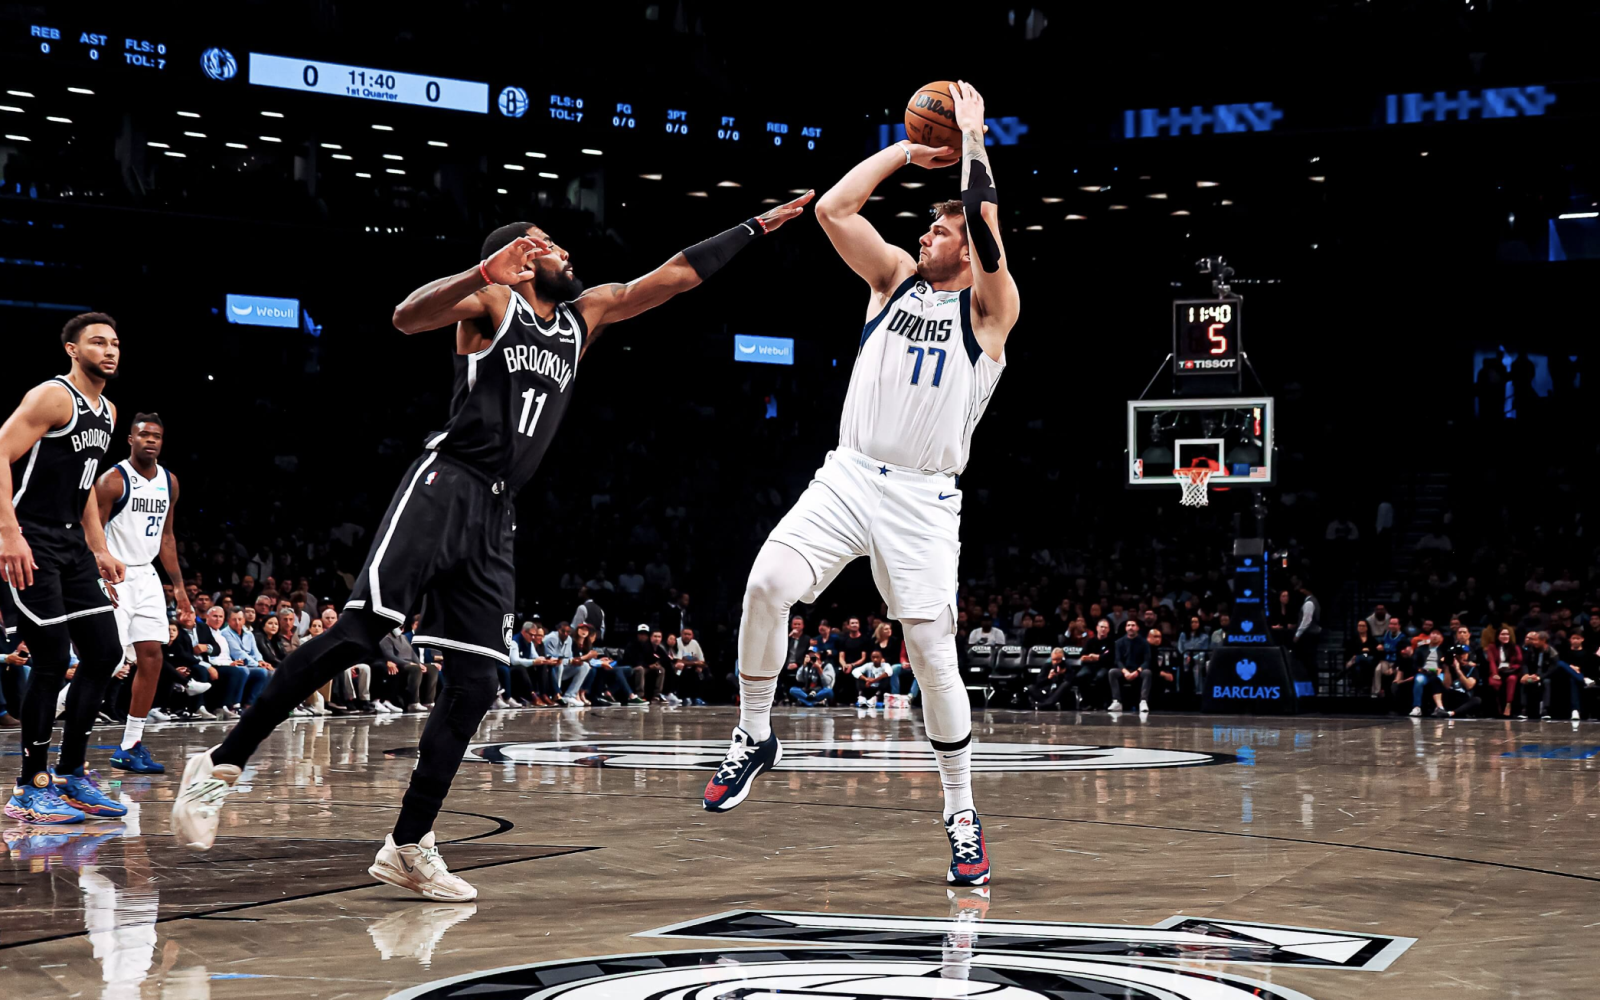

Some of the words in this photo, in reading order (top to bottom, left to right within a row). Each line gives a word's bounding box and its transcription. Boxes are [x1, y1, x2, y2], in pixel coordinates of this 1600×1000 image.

[31, 25, 60, 39] REB
[80, 32, 107, 46] AST
[41, 43, 50, 53] 0
[125, 39, 154, 52] FLS:
[157, 44, 166, 55] 0
[90, 49, 99, 60] 0
[124, 53, 155, 67] TOL:
[158, 59, 166, 69] 7
[303, 65, 318, 87] 0
[348, 70, 396, 90] 11:40
[346, 86, 360, 96] 1st
[362, 88, 398, 100] Quarter
[425, 81, 441, 102] 0
[550, 95, 574, 107] FLS:
[576, 99, 583, 109] 0
[616, 103, 632, 114] FG
[916, 94, 956, 121] Wilso
[549, 108, 575, 120] TOL:
[576, 113, 583, 122] 7
[667, 110, 687, 121] 3PT
[721, 116, 735, 127] FT
[766, 122, 788, 134] REB
[801, 127, 822, 138] AST
[774, 136, 782, 146] 0
[807, 140, 815, 150] 0
[256, 305, 294, 318] Webull
[1189, 305, 1231, 323] 11:40
[886, 308, 953, 343] DALLAS
[1208, 323, 1227, 354] 5
[907, 345, 947, 388] 77
[1194, 359, 1236, 369] TISSOT
[518, 387, 548, 437] 11
[71, 428, 111, 453] BROOKLY
[79, 457, 99, 490] 10
[131, 497, 167, 513] DALLAS
[145, 516, 162, 537] 25
[1227, 634, 1267, 643] BARCLAYS
[1212, 685, 1281, 700] BARCLAYS
